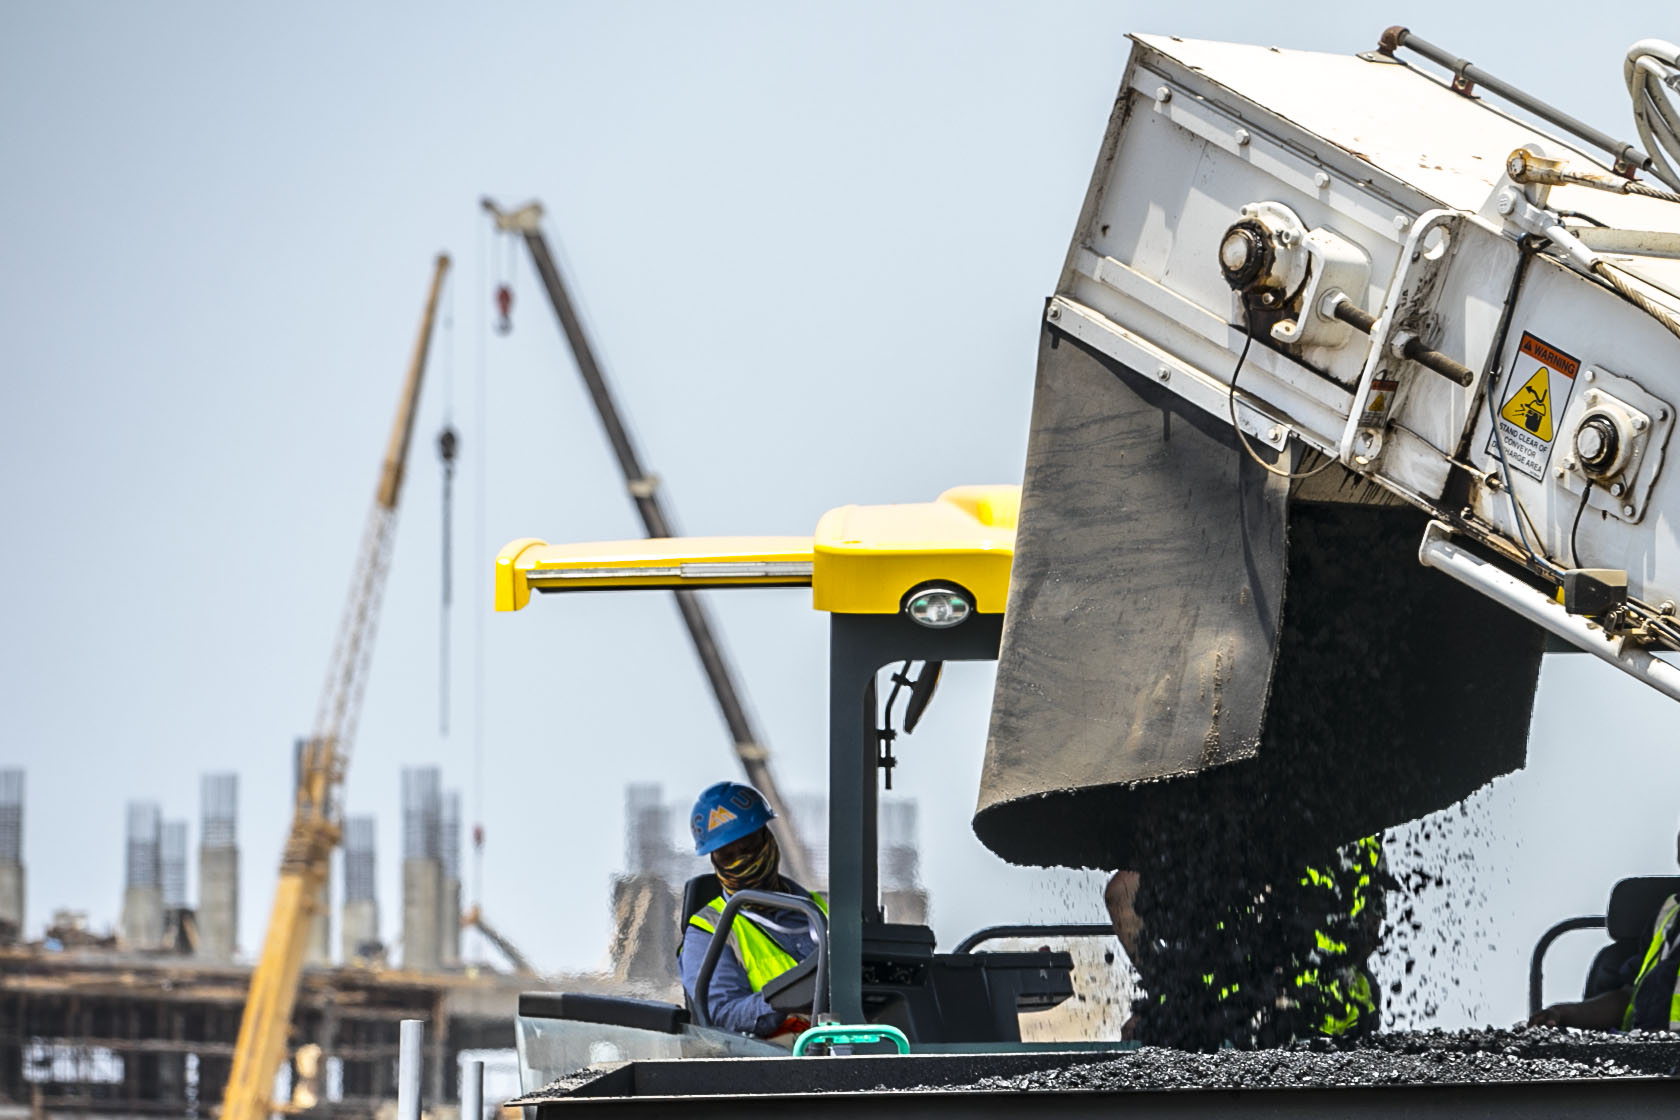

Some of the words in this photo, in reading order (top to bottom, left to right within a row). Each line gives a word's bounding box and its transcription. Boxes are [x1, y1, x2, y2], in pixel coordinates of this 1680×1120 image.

[1534, 345, 1576, 375] WARNING
[1499, 422, 1518, 438] STAND
[1518, 432, 1538, 449] CLEAR
[1538, 442, 1548, 453] OF
[1503, 436, 1536, 459] CONVEYOR
[1491, 440, 1526, 464] DHARGE
[1526, 457, 1542, 473] AREA
